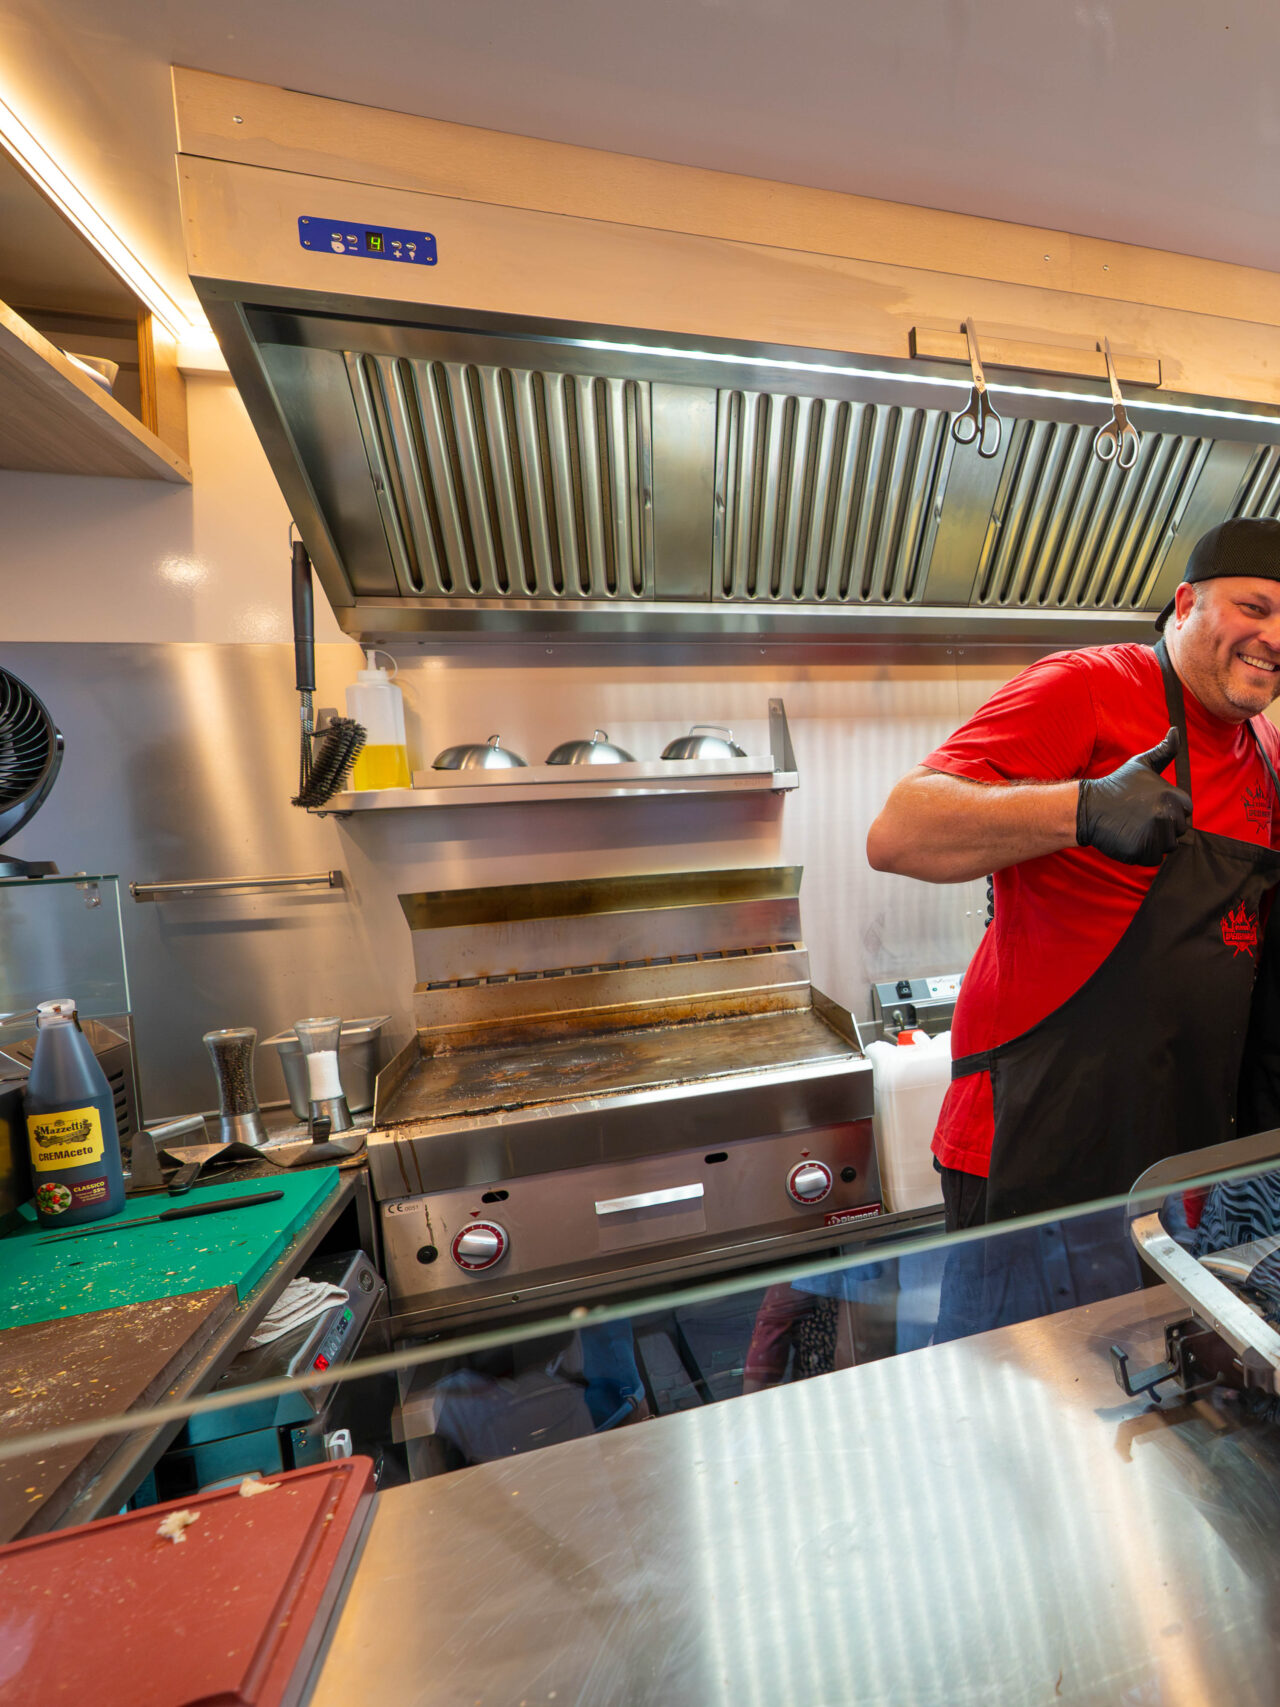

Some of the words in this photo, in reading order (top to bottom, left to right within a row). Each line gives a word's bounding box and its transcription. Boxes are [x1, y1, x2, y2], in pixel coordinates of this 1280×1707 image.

[40, 1121, 83, 1135] Mazzetti
[38, 1147, 93, 1161] CREMAceto
[73, 1181, 105, 1192] CLASSICO
[840, 1209, 879, 1223] Diamond
